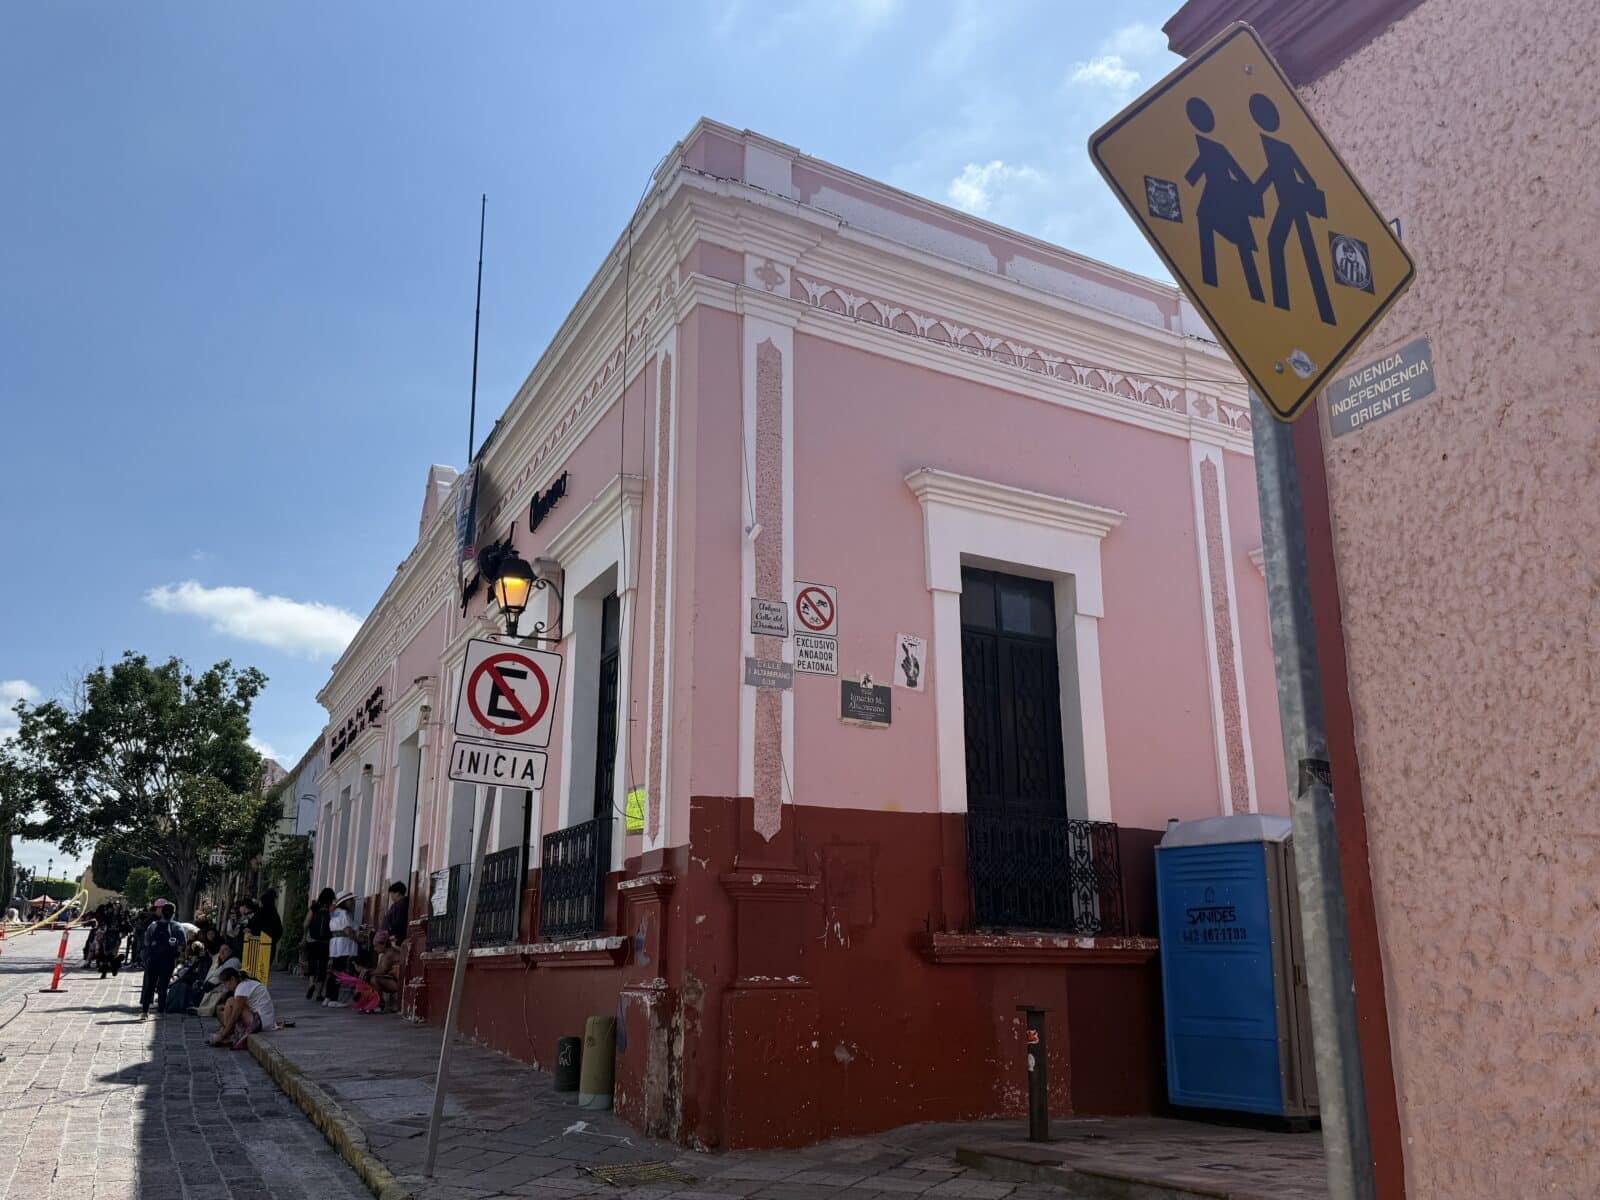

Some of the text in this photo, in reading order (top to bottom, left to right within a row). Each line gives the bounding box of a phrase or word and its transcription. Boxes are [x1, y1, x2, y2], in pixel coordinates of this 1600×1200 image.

[1348, 353, 1403, 391] AVENIDA
[1331, 359, 1429, 417] INDEPENDENCIA
[1350, 387, 1412, 428] ORIENTE
[796, 637, 835, 651] EXCLUSIVO
[798, 648, 833, 661] ANDADOR
[797, 659, 835, 673] PEATONAL
[458, 750, 535, 781] INICIA
